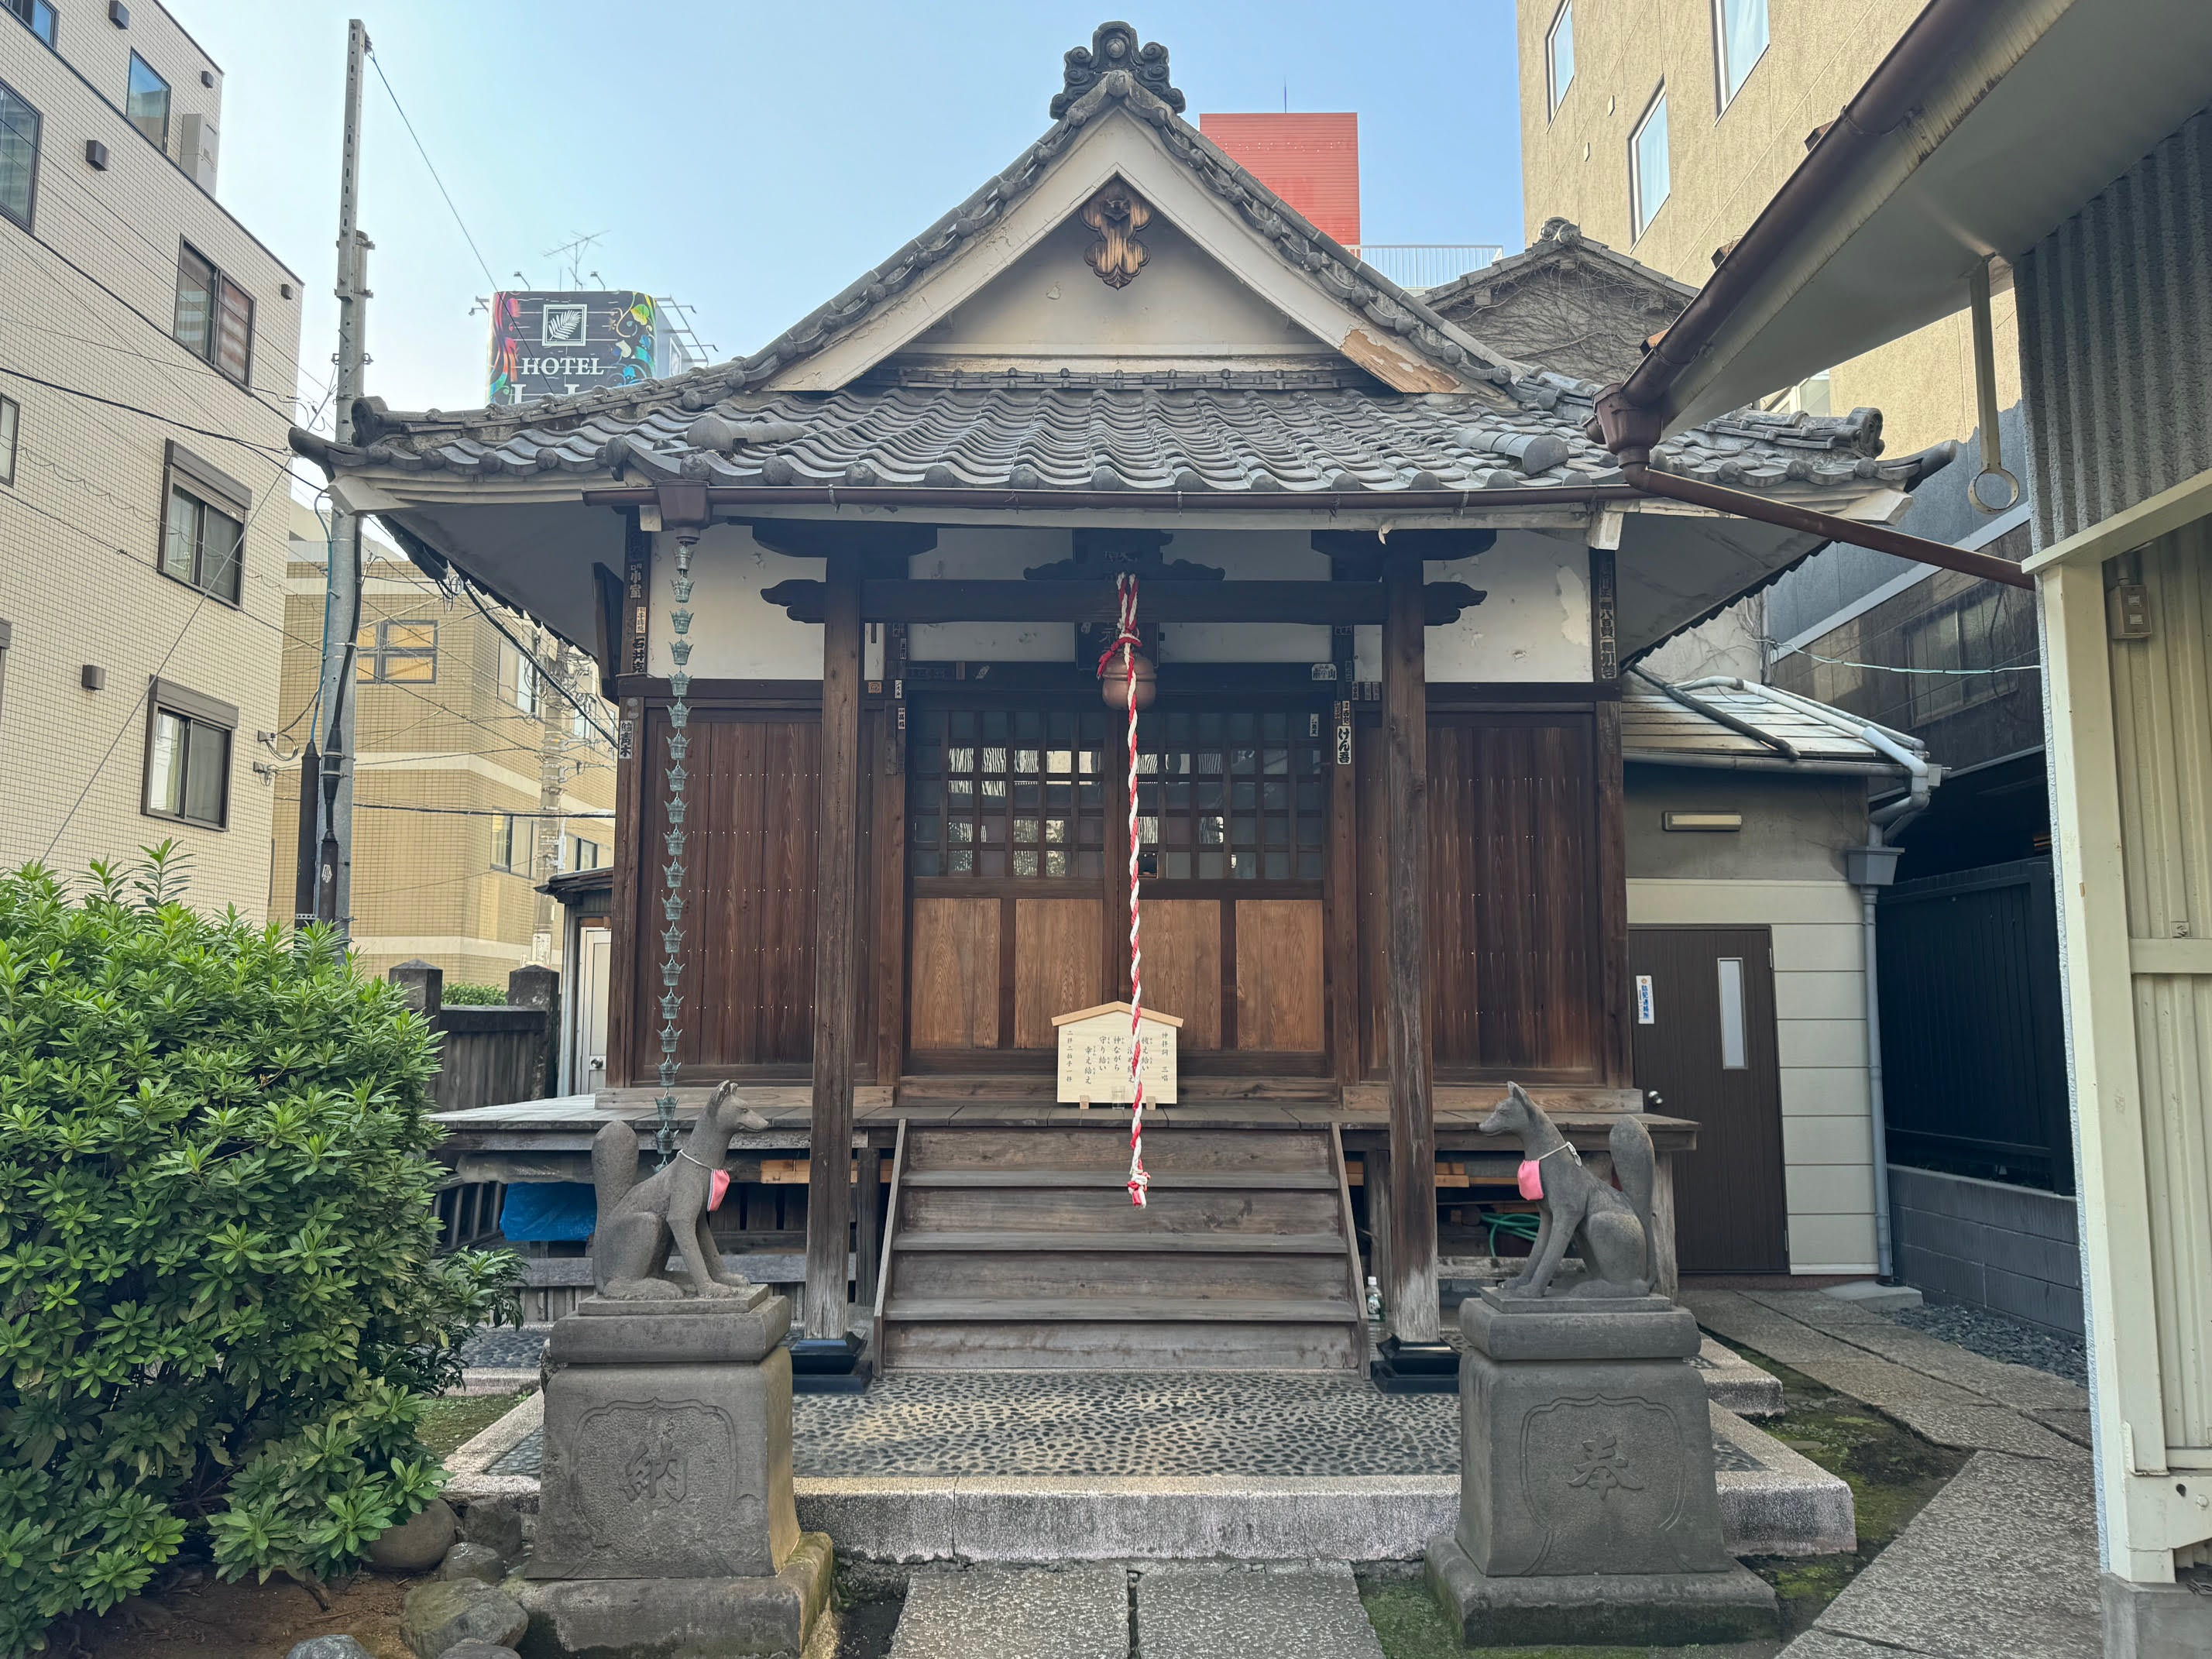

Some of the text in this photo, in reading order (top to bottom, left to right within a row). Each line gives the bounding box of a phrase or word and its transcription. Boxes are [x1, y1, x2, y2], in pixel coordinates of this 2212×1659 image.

[521, 357, 604, 376] HOTEL
[1338, 728, 1350, 764] けん吾
[620, 1437, 688, 1503] 納
